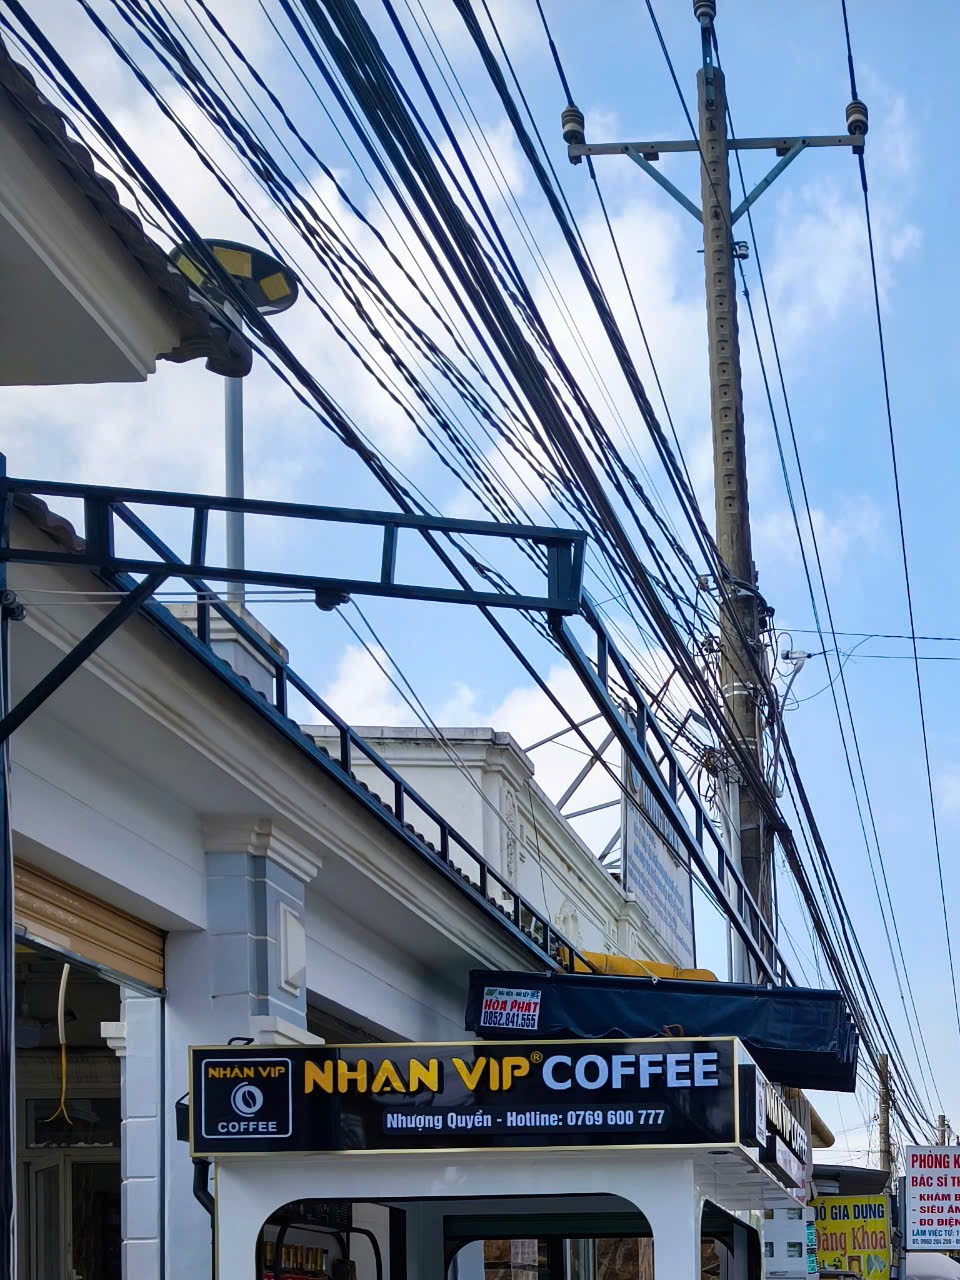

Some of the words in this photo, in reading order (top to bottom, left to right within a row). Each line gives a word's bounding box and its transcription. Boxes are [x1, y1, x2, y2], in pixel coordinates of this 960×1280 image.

[258, 1066, 286, 1078] VIP
[543, 1052, 719, 1090] COFFEE
[217, 1121, 278, 1132] COFFEE
[386, 1113, 442, 1131] Nhượng
[447, 1109, 492, 1130] Quyền
[507, 1111, 563, 1126] Hotline:
[567, 1110, 603, 1126] 0769
[607, 1110, 634, 1125] 600
[638, 1109, 665, 1124] 777
[911, 1150, 950, 1168] PHÒNG
[911, 1173, 933, 1187] BÁC
[937, 1173, 947, 1187] SĨ
[920, 1192, 951, 1201] KHÁM
[831, 1204, 849, 1220] GIA
[853, 1203, 885, 1222] DỤNG
[920, 1204, 944, 1213] SIÊU
[919, 1218, 933, 1226] ĐO
[852, 1225, 886, 1250] Khoa
